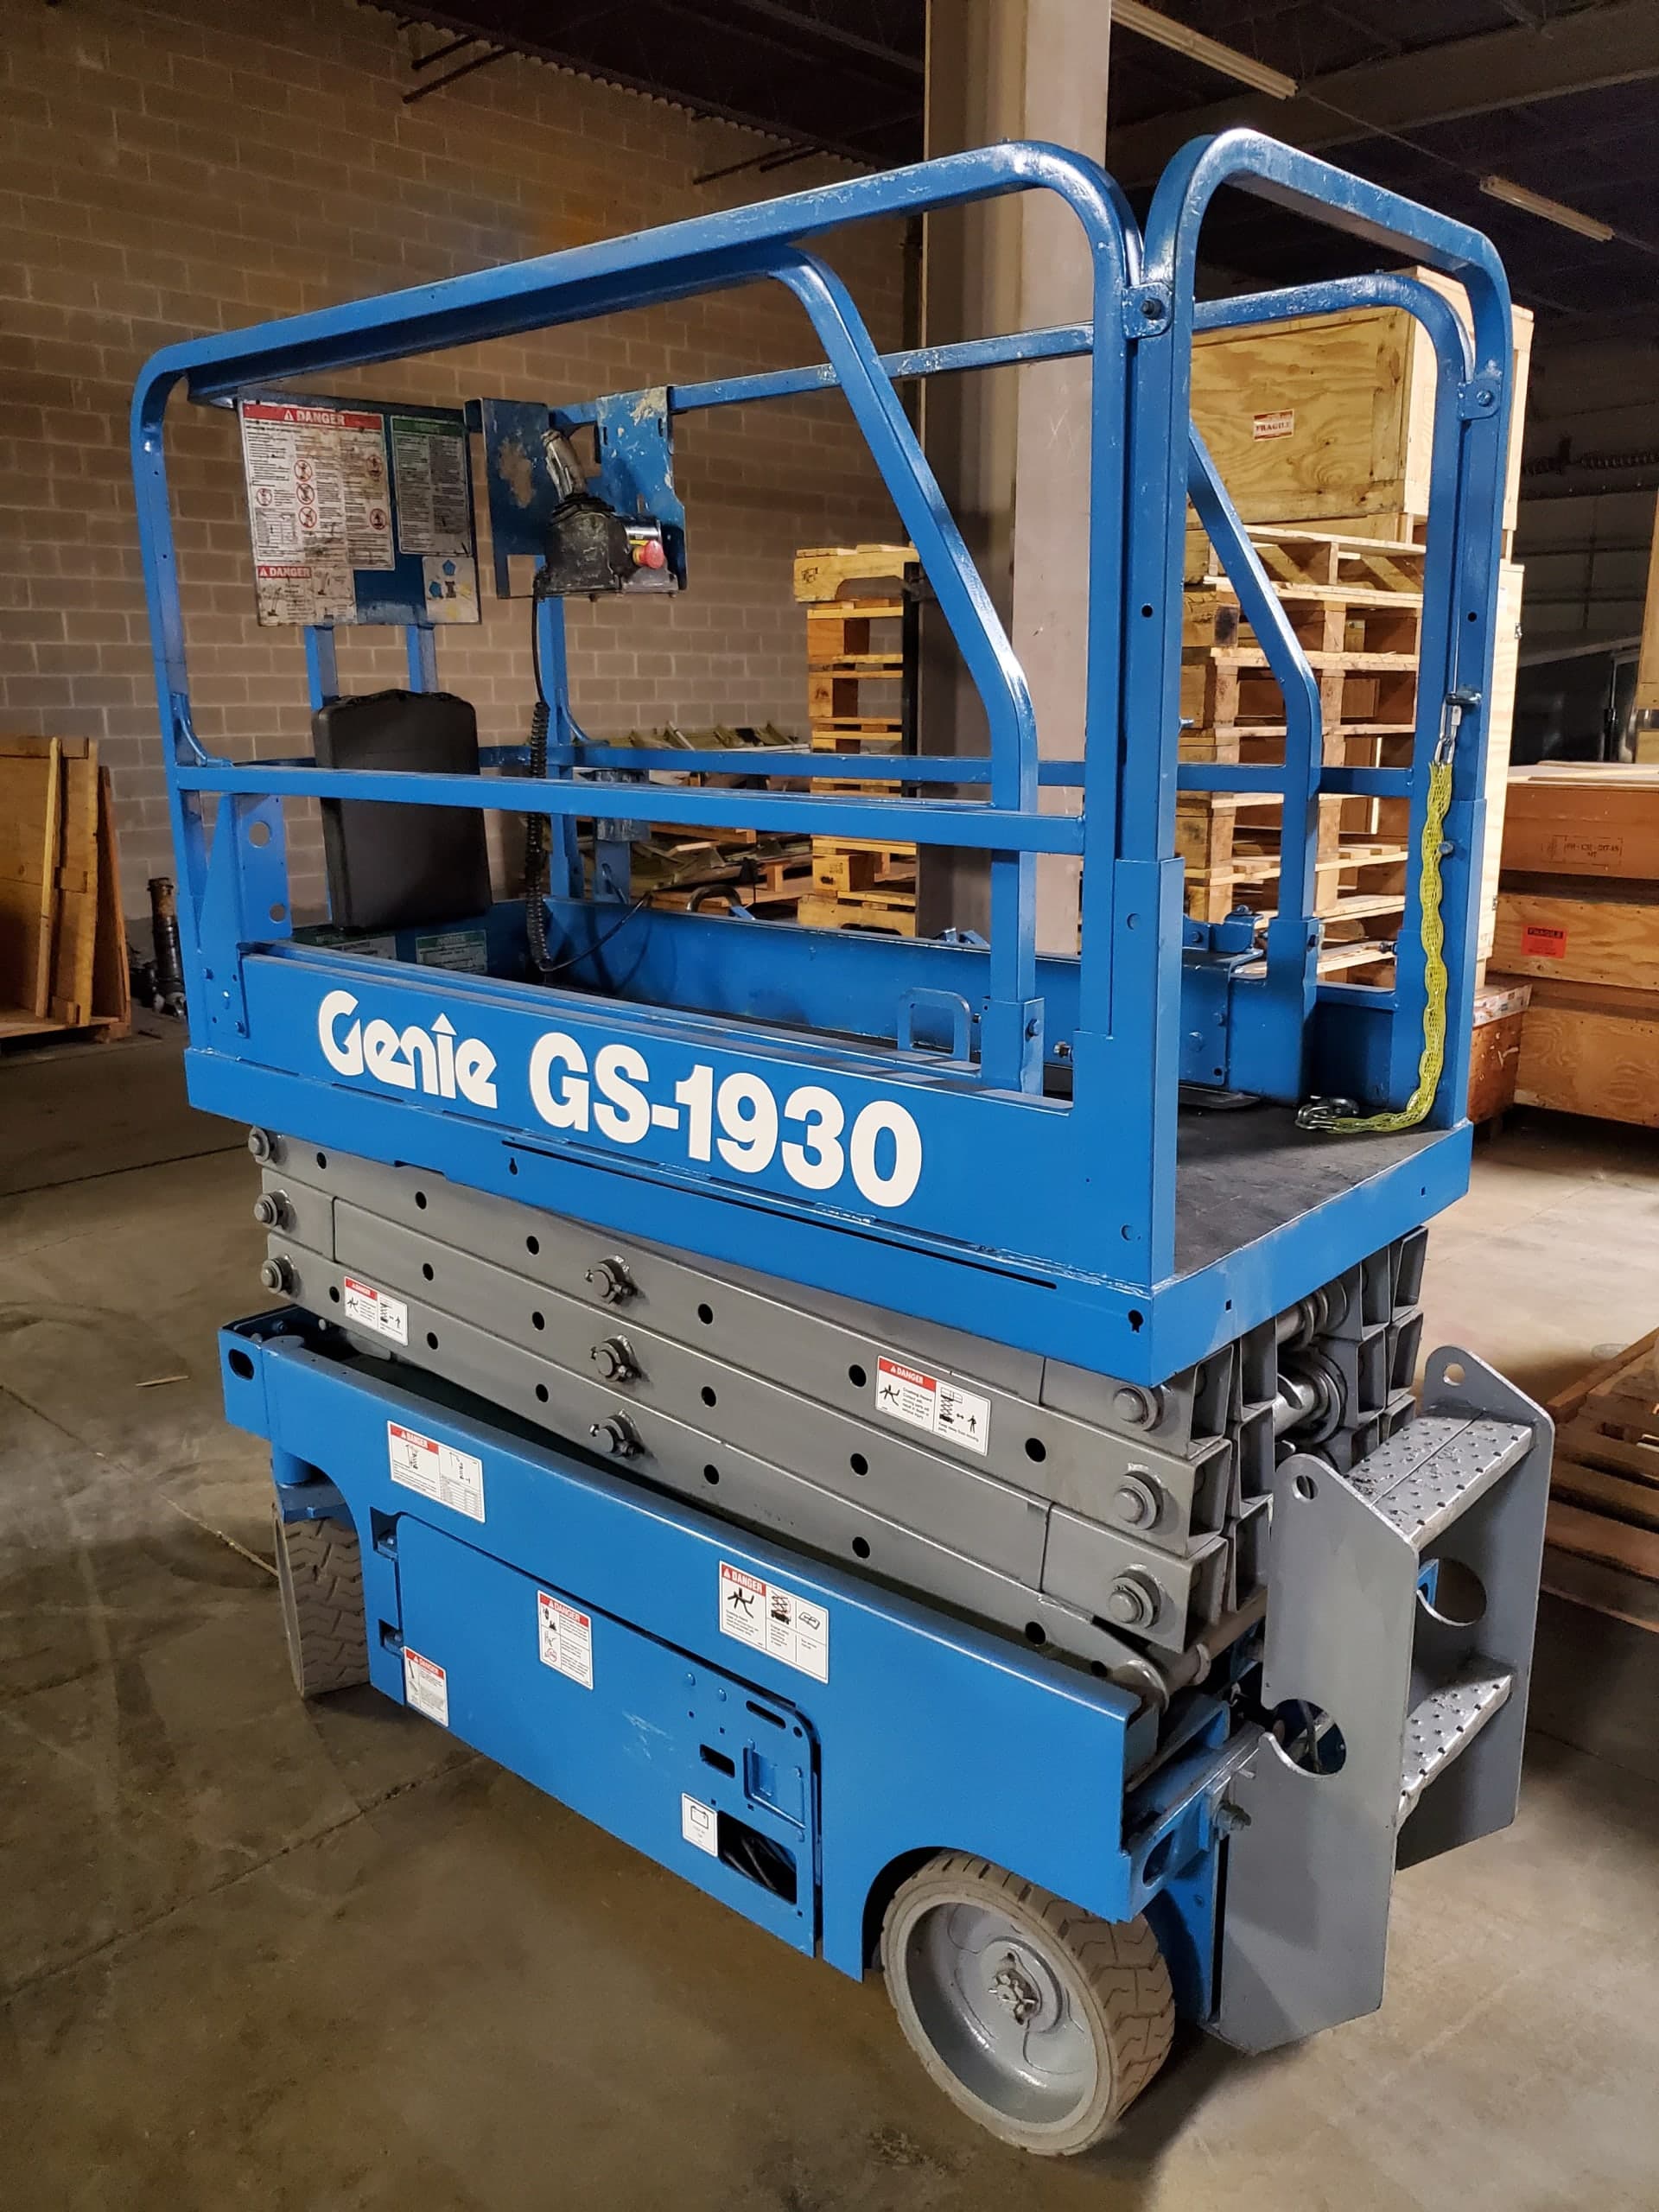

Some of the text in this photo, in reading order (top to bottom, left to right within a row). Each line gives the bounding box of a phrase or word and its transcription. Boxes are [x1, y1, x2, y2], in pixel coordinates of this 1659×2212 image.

[296, 410, 346, 426] DANGER
[269, 567, 310, 577] DANGER
[318, 989, 922, 1208] Genie GS-1930
[897, 1366, 924, 1384] DANGER
[732, 1568, 763, 1593] DANGER
[556, 1603, 581, 1622] DANGER
